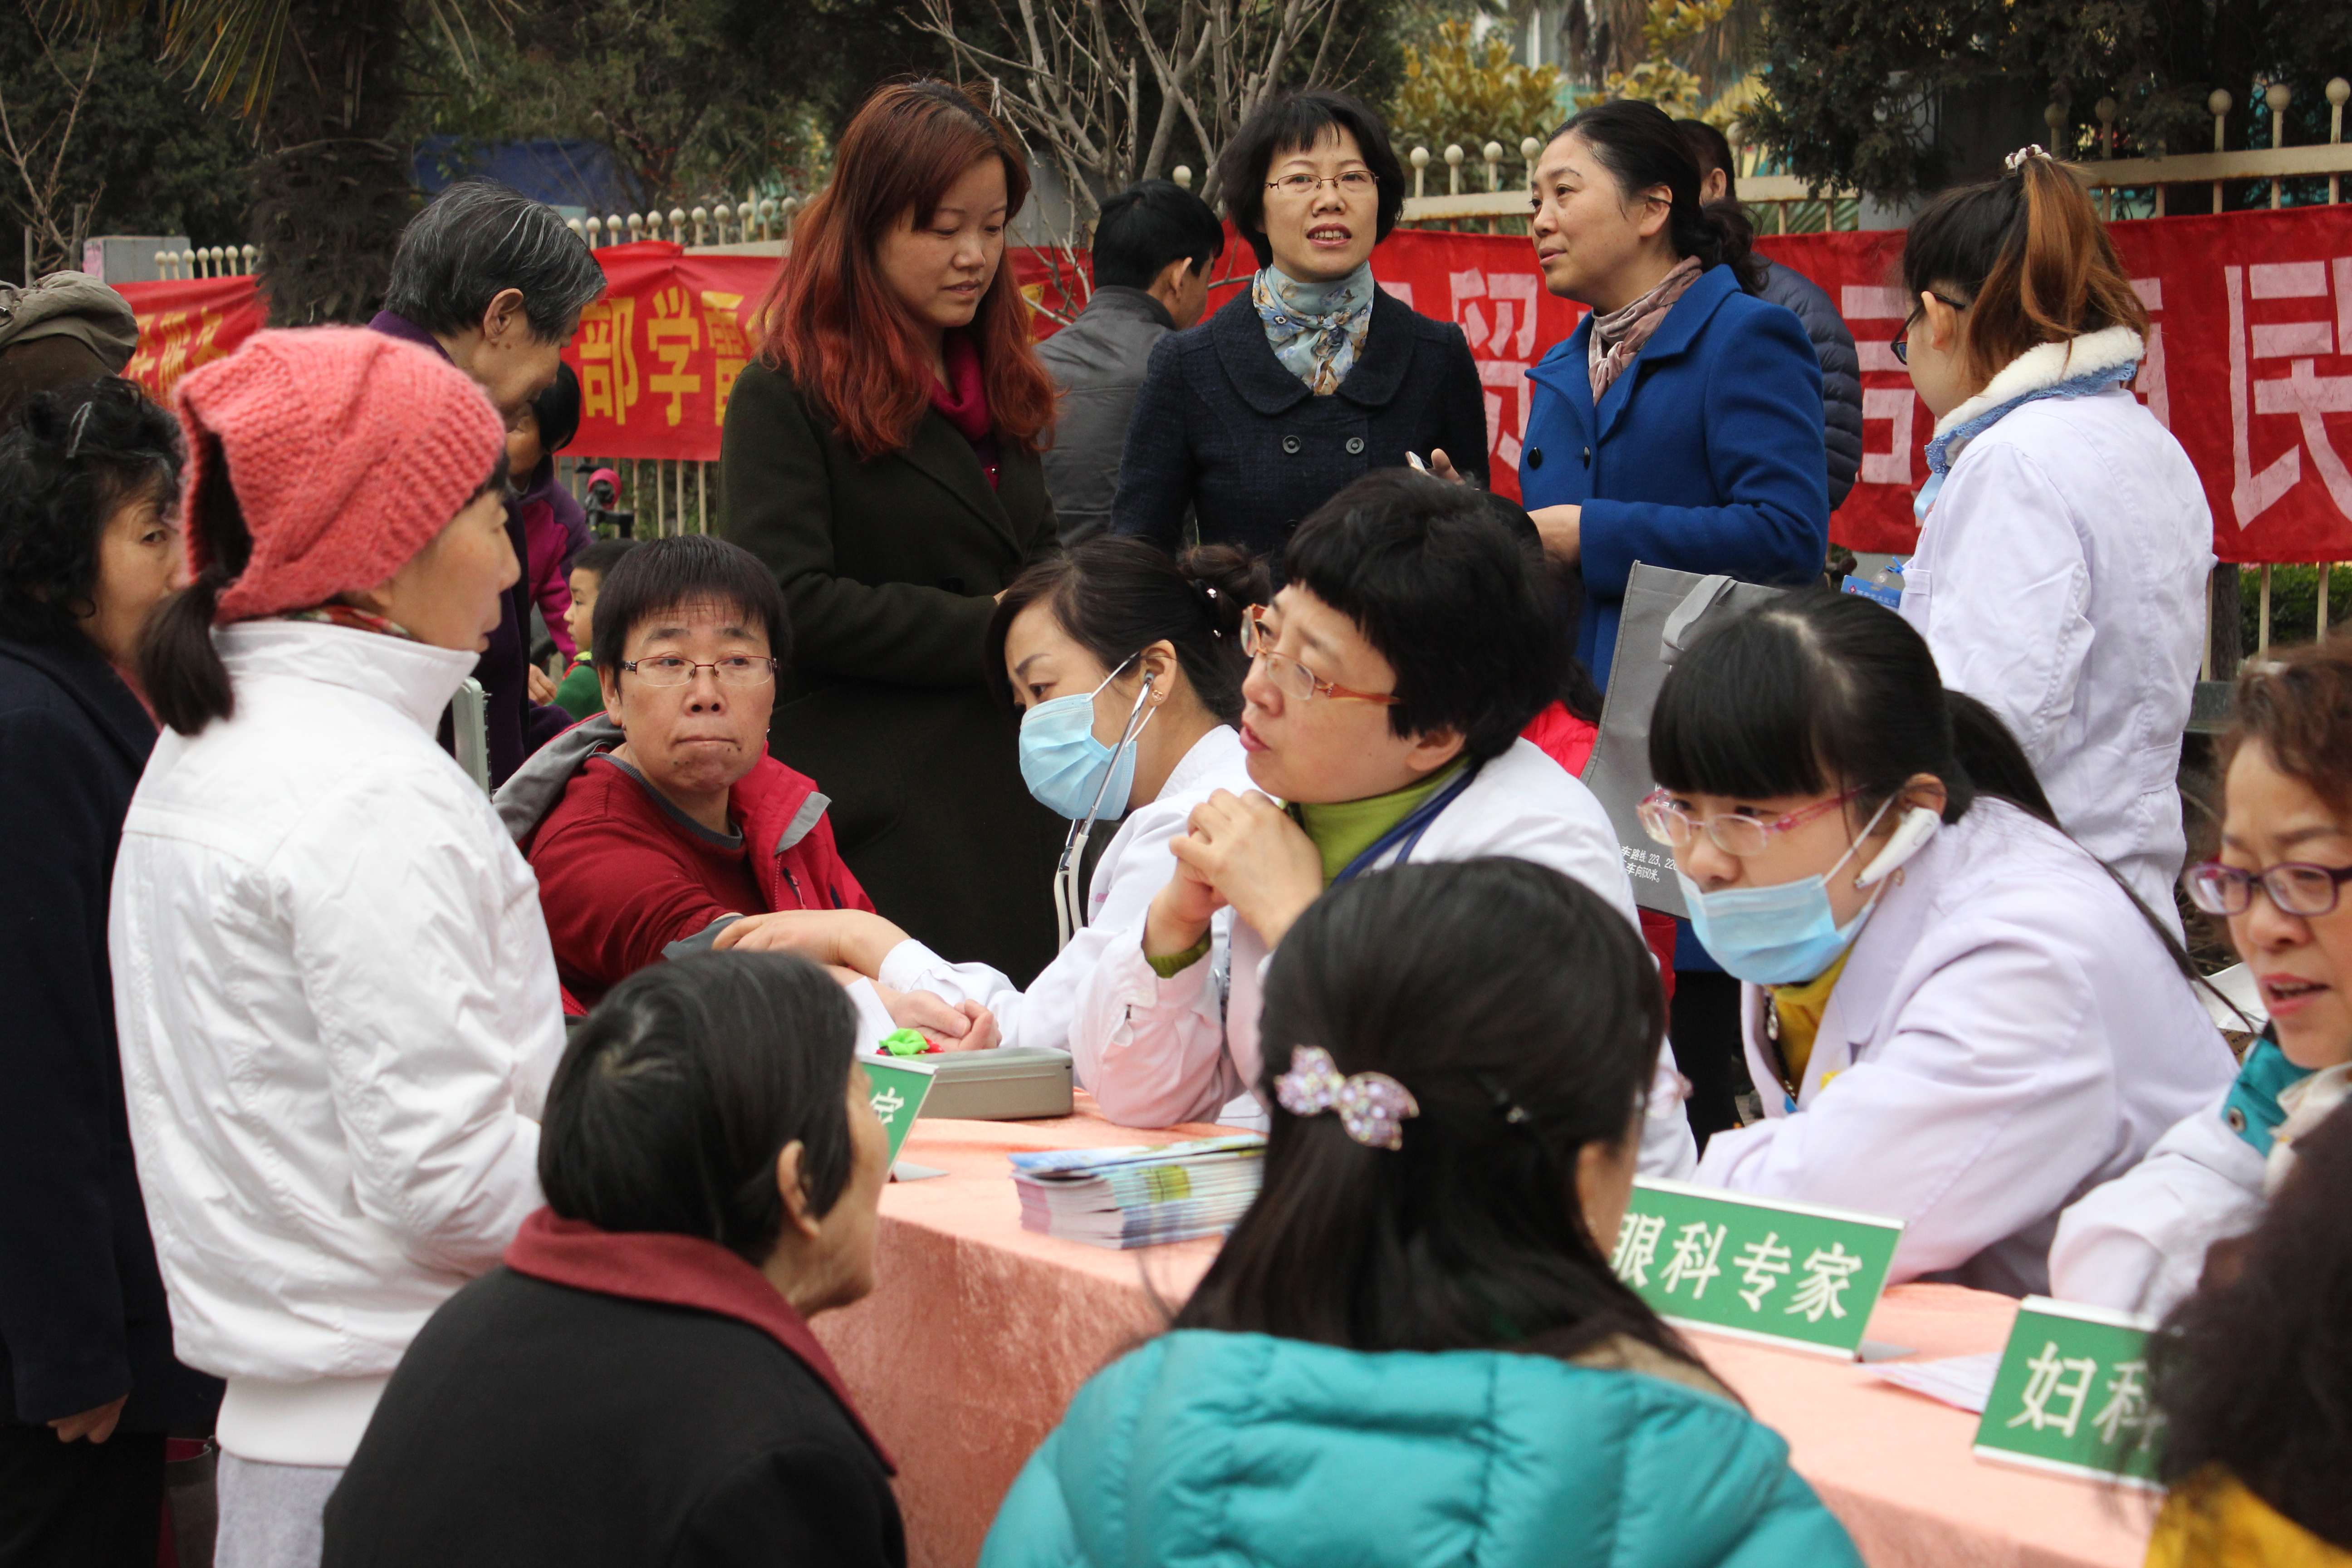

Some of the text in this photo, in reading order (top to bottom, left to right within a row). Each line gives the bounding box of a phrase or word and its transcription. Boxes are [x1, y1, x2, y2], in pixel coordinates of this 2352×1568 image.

[579, 286, 774, 426] 部学雷
[1617, 843, 1646, 863] 车路线
[1608, 1212, 1863, 1323] 眼科专家
[2006, 1341, 2168, 1453] 妇科
